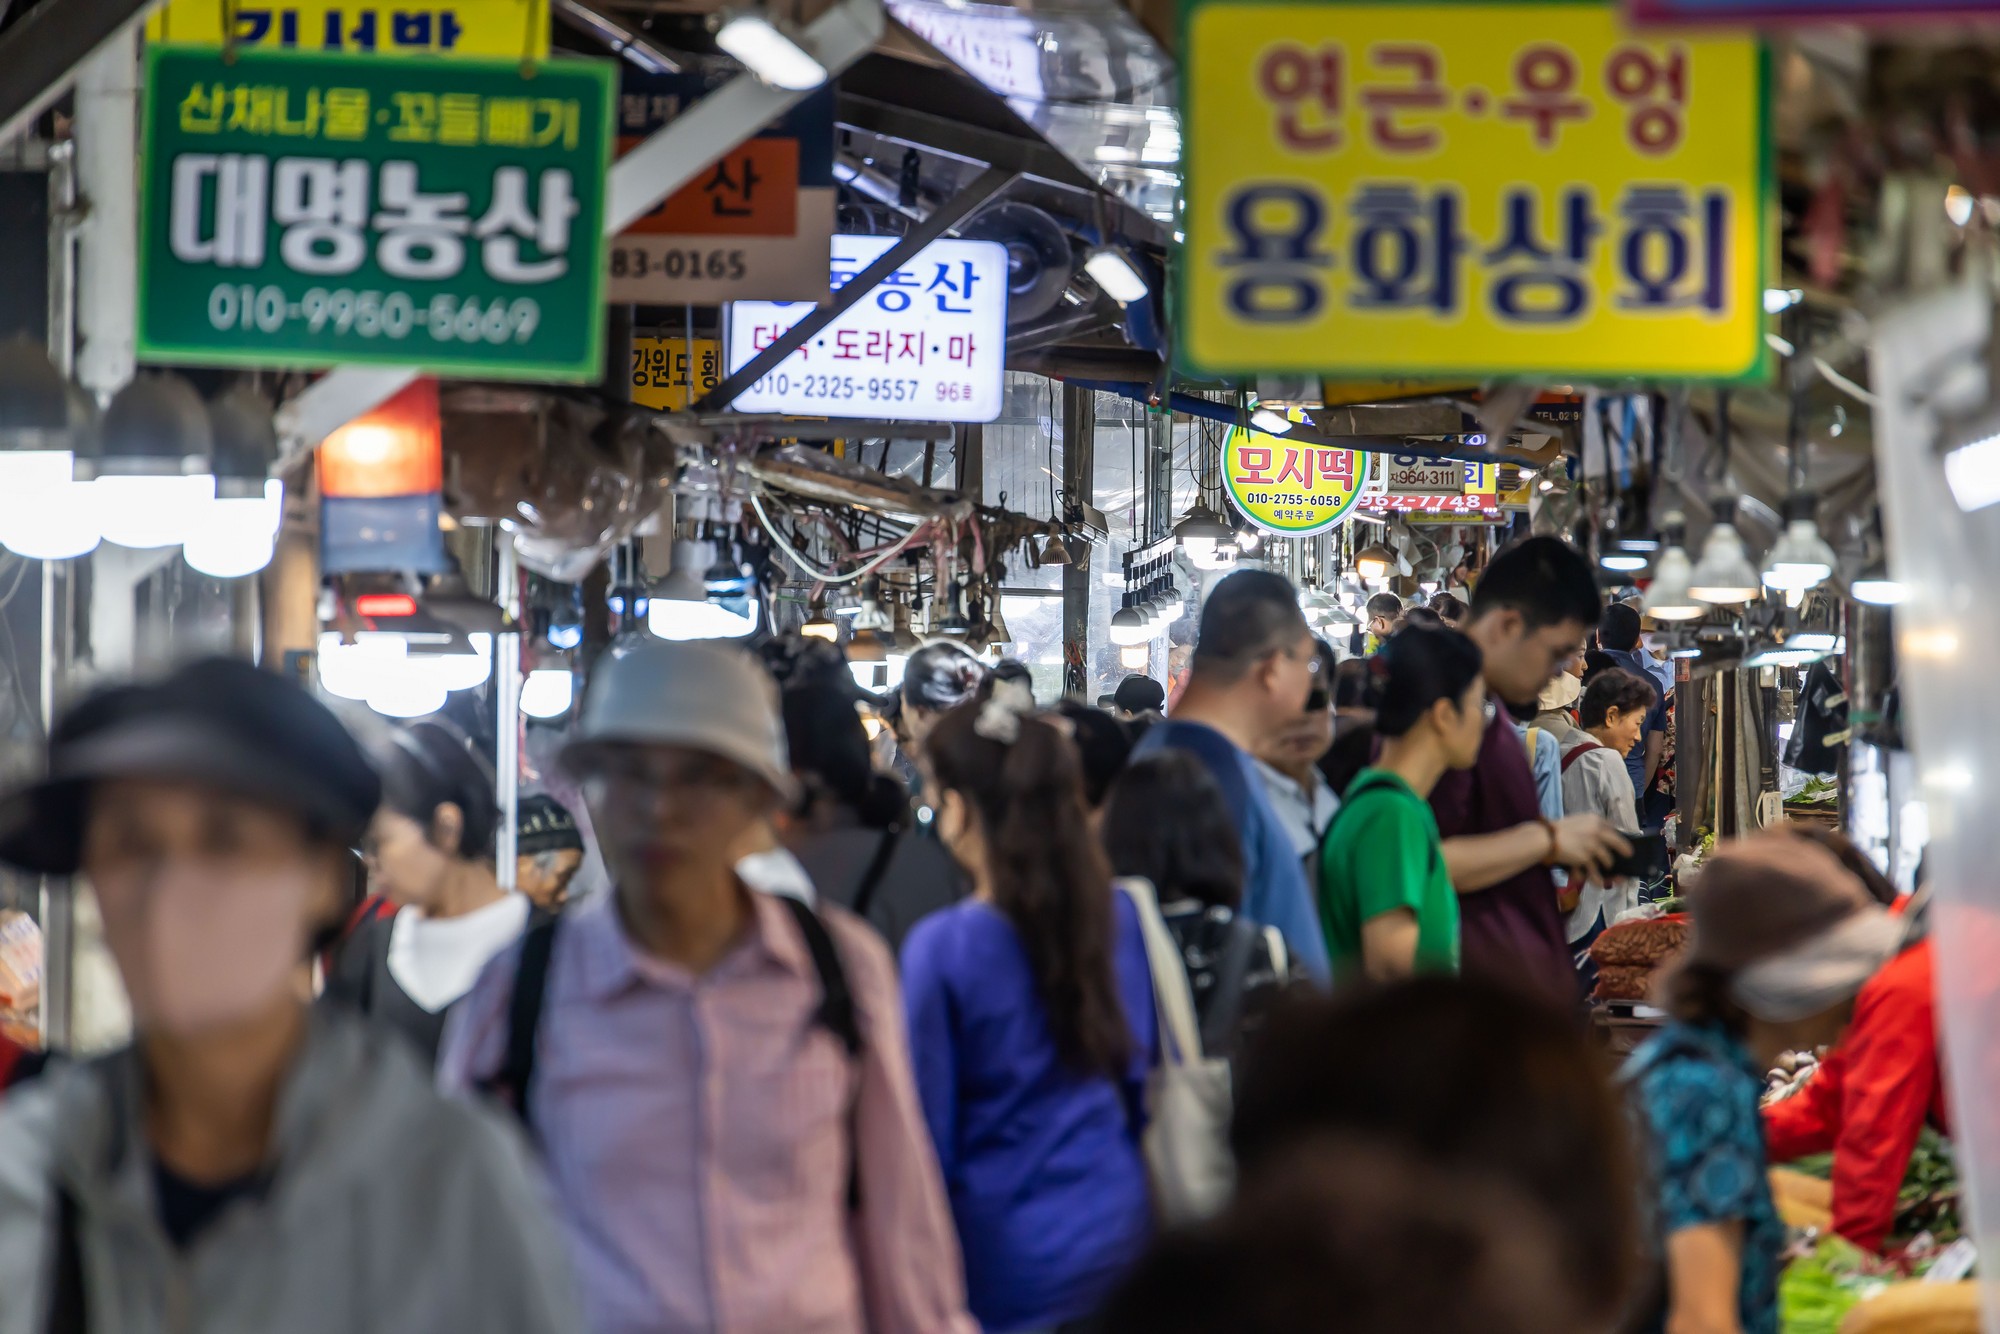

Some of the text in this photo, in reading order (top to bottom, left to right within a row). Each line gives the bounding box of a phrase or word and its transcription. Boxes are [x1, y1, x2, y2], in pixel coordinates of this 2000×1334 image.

[1257, 43, 1690, 155] 연근·우엉
[170, 152, 579, 283] 대명농산
[1212, 182, 1729, 325] 용화상회
[208, 283, 541, 344] 010-9950-5669
[632, 348, 693, 388] 강원도
[753, 324, 977, 369] 더·도라지·마
[752, 373, 919, 401] 010-2325-9557
[1236, 447, 1354, 492] 모시떡
[1247, 492, 1341, 507] 010-2755-6058
[1273, 509, 1315, 521] 예약주문
